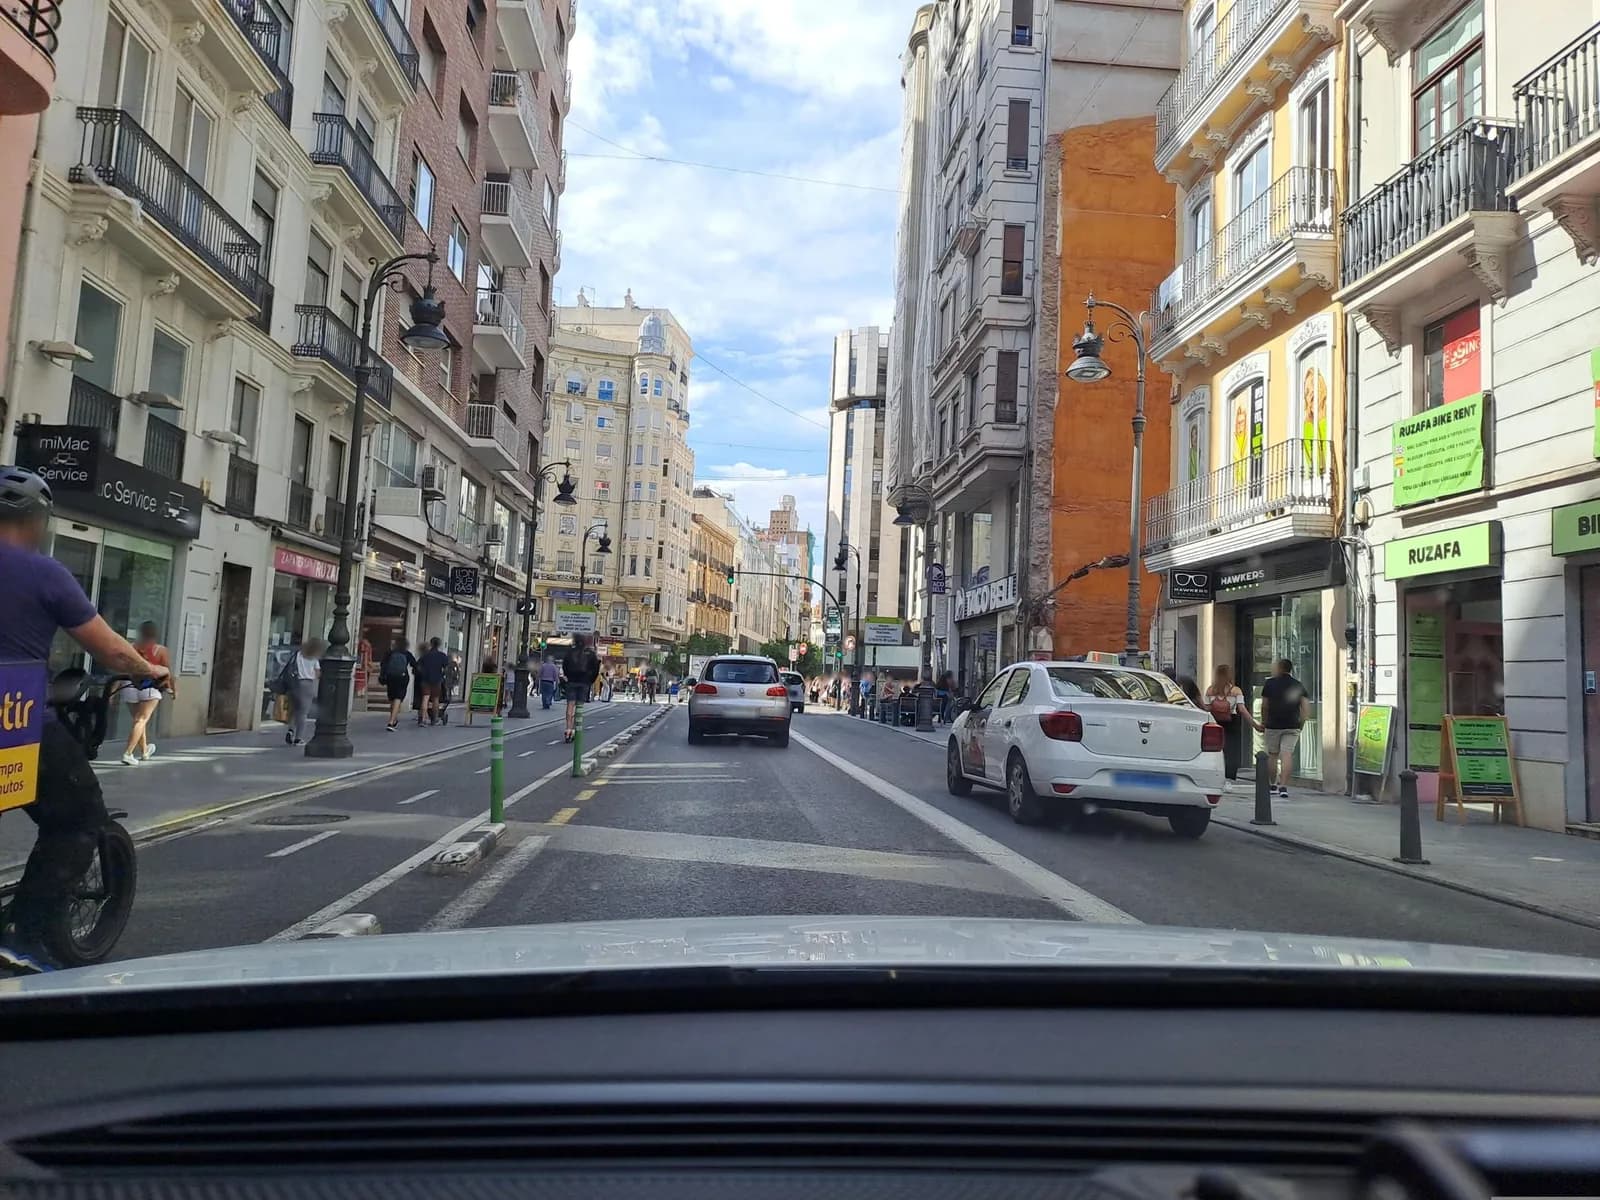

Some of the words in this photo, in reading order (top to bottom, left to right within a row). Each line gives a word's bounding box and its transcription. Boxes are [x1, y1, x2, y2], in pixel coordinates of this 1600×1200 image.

[1399, 418, 1431, 437] RUZAFA
[1432, 411, 1452, 427] BIKE
[1453, 404, 1477, 421] RENT
[39, 435, 90, 451] miMac
[38, 466, 89, 481] Service
[114, 480, 157, 513] Service
[1408, 540, 1461, 565] RUZAFA
[1221, 569, 1265, 585] HAWKERS
[966, 585, 989, 617] TACO
[990, 575, 1016, 610] BELL
[0, 691, 34, 731] tir
